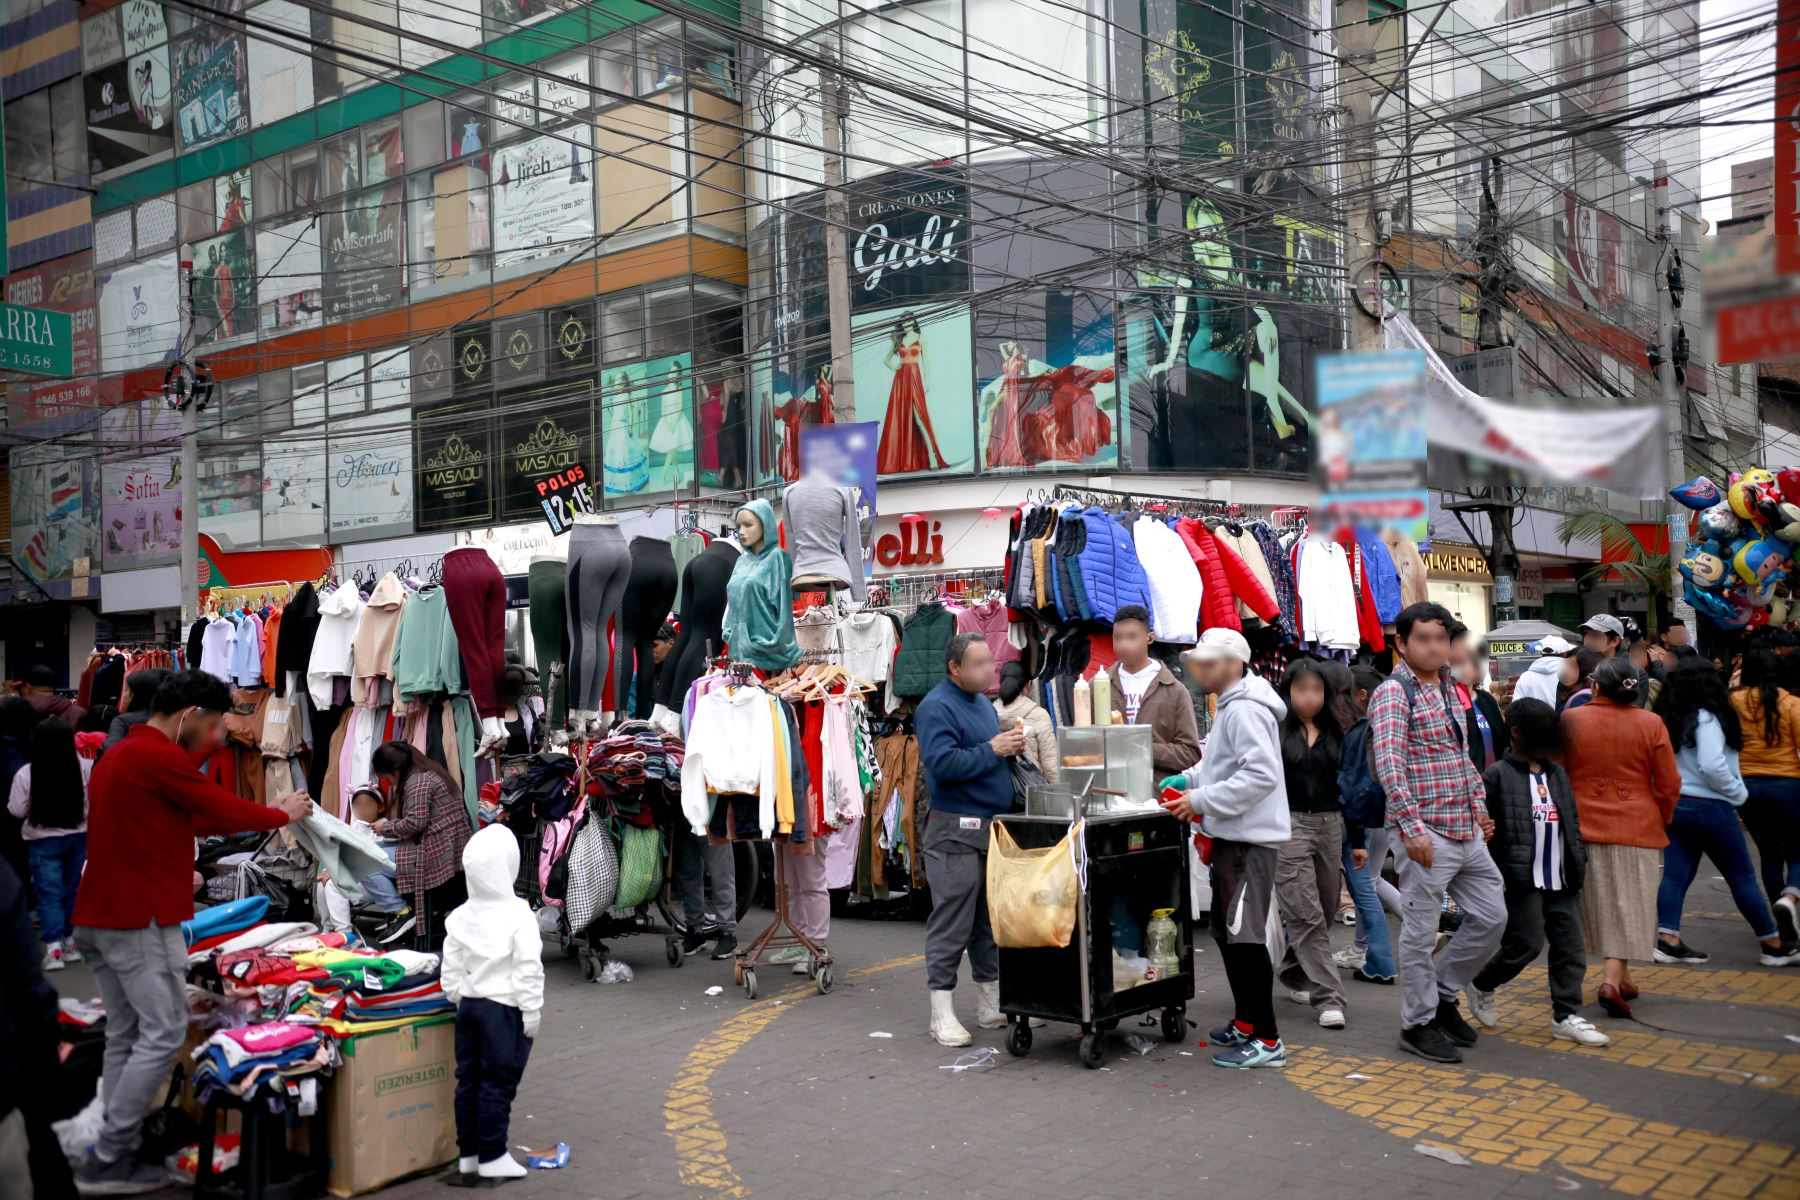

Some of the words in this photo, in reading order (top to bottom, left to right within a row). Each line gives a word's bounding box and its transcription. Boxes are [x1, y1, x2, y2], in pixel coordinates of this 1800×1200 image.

[1273, 122, 1304, 140] GILDA
[515, 155, 551, 188] Jireh
[859, 189, 956, 217] CREACIONES
[14, 352, 51, 369] 1558
[59, 390, 73, 403] 539
[515, 450, 580, 473] MASAQUI
[426, 467, 483, 487] MASAQUI
[536, 465, 585, 496] POLOS
[872, 520, 944, 567] elli
[1493, 643, 1517, 653] DULCE
[1534, 812, 1547, 821] 47
[378, 1066, 445, 1091] USTERIZED
